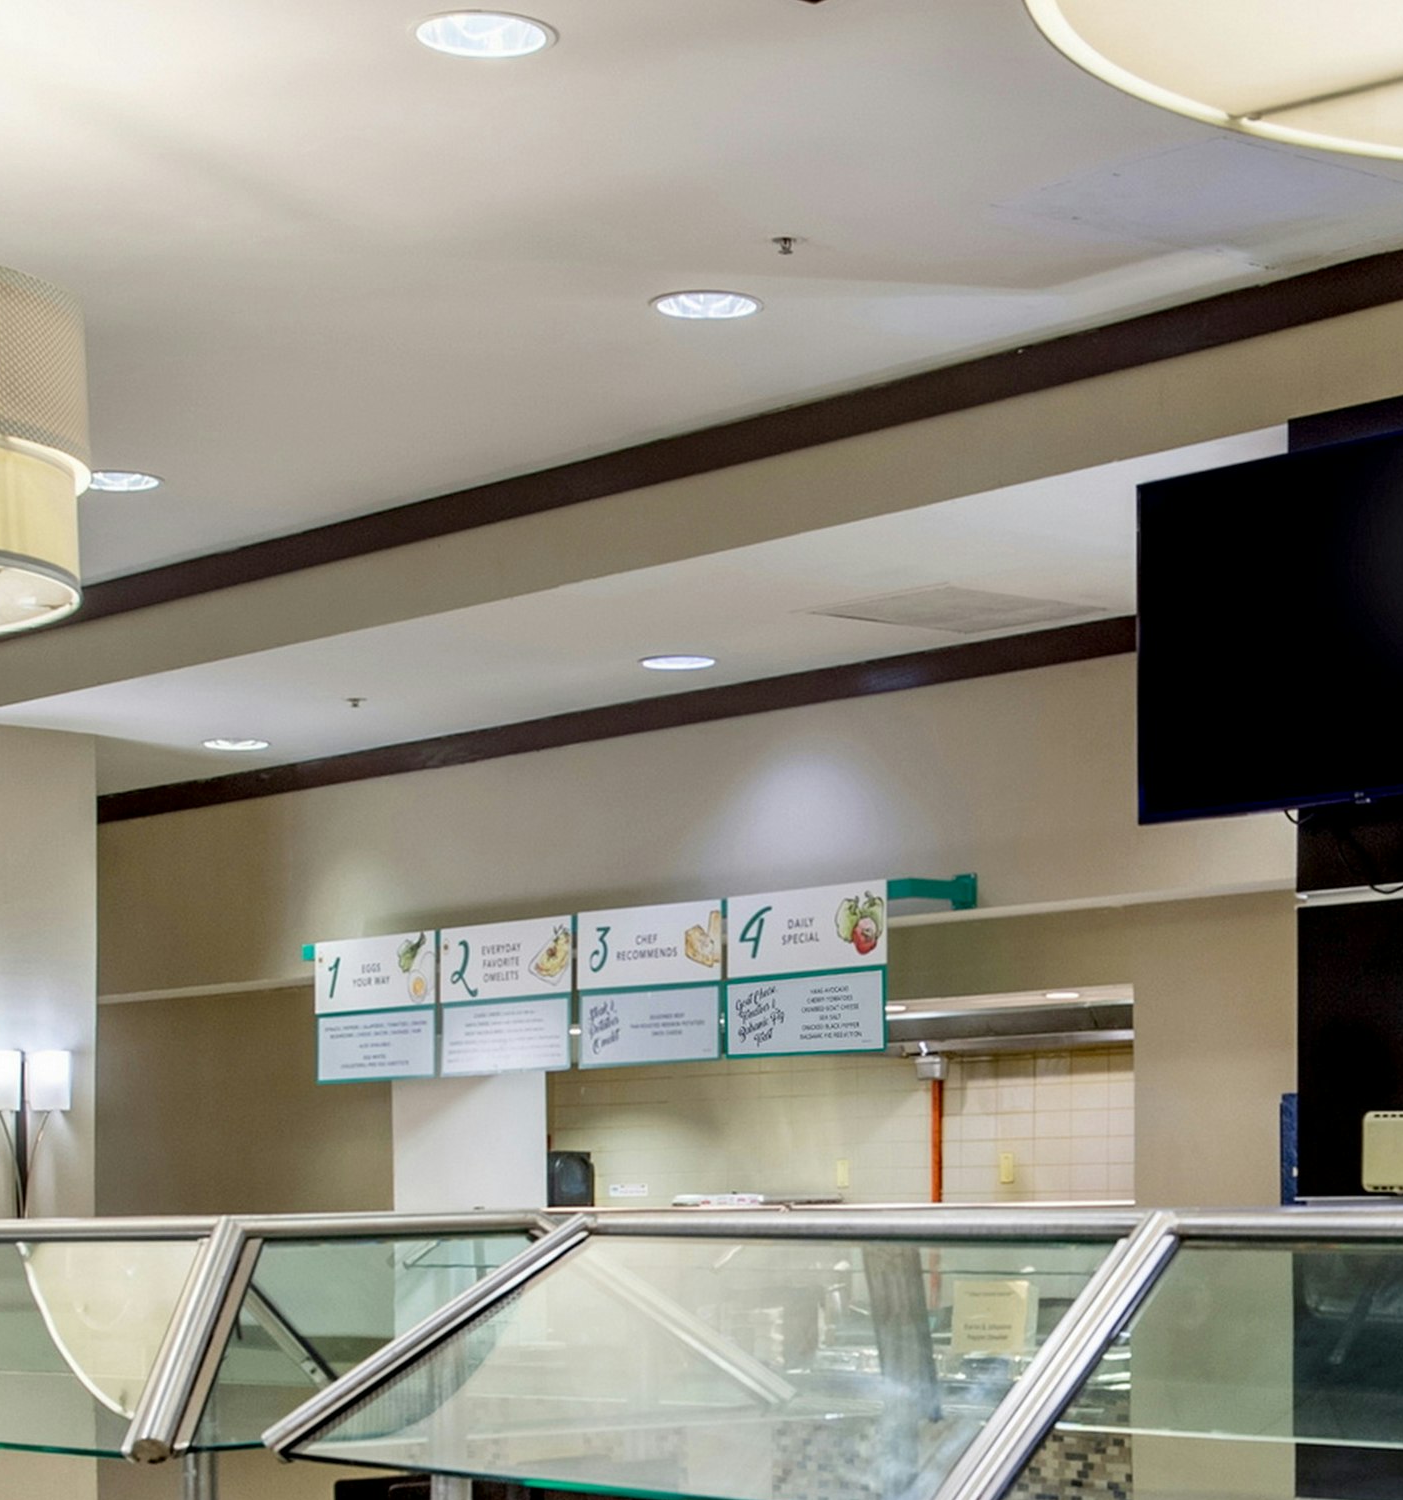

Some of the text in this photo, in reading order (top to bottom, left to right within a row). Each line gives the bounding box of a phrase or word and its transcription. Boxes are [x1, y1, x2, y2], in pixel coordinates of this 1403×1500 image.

[787, 917, 814, 929] DAILY
[739, 906, 773, 959] 4
[781, 932, 820, 945] SPECIAL
[635, 933, 658, 946] CHEF
[481, 942, 522, 956] EVERYDAY
[589, 926, 611, 973] 3
[616, 946, 678, 961] RECOMMENDS
[361, 962, 381, 974] EGGS
[450, 939, 478, 997] 2
[482, 956, 520, 969] FAVORITE
[328, 957, 341, 999] 1
[352, 976, 390, 988] YOUR WAY
[483, 970, 519, 983] OMELETS
